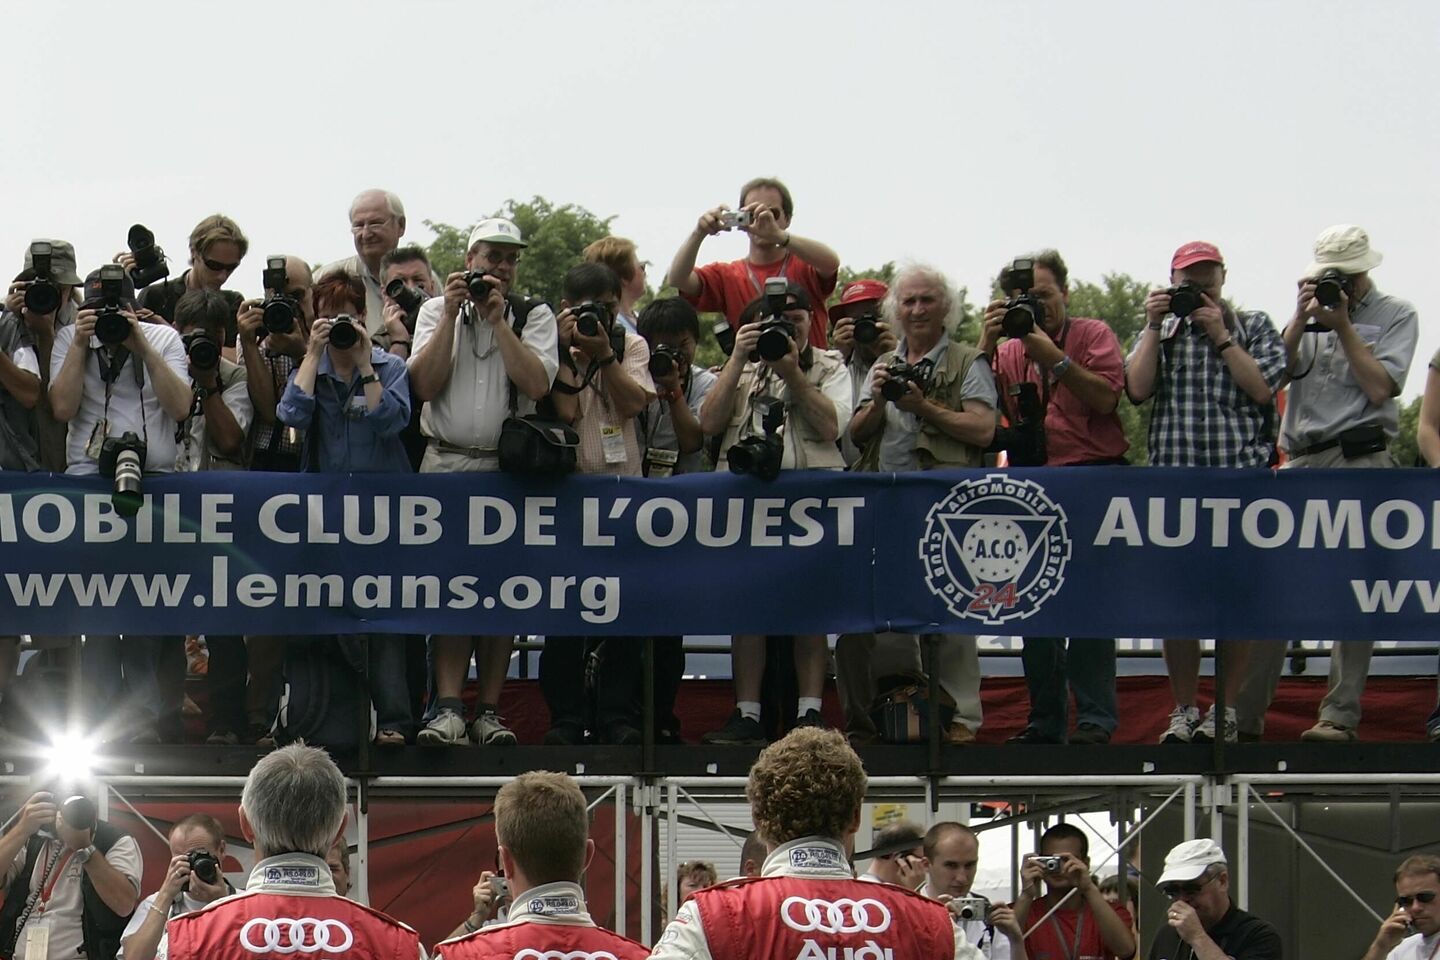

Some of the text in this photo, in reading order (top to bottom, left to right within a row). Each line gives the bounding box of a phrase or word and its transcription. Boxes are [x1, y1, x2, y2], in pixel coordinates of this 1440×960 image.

[258, 493, 443, 545] CLUB
[468, 496, 557, 546] DE
[582, 496, 865, 547] L'OUEST
[948, 483, 1049, 513] AUTOMOBILE
[1093, 496, 1440, 550] AUTOMO
[930, 531, 946, 577] CLUB
[1027, 534, 1062, 602] L'OUEST
[4, 555, 620, 624] www.lemans.org
[944, 582, 964, 603] DE
[968, 582, 1020, 612] 24
